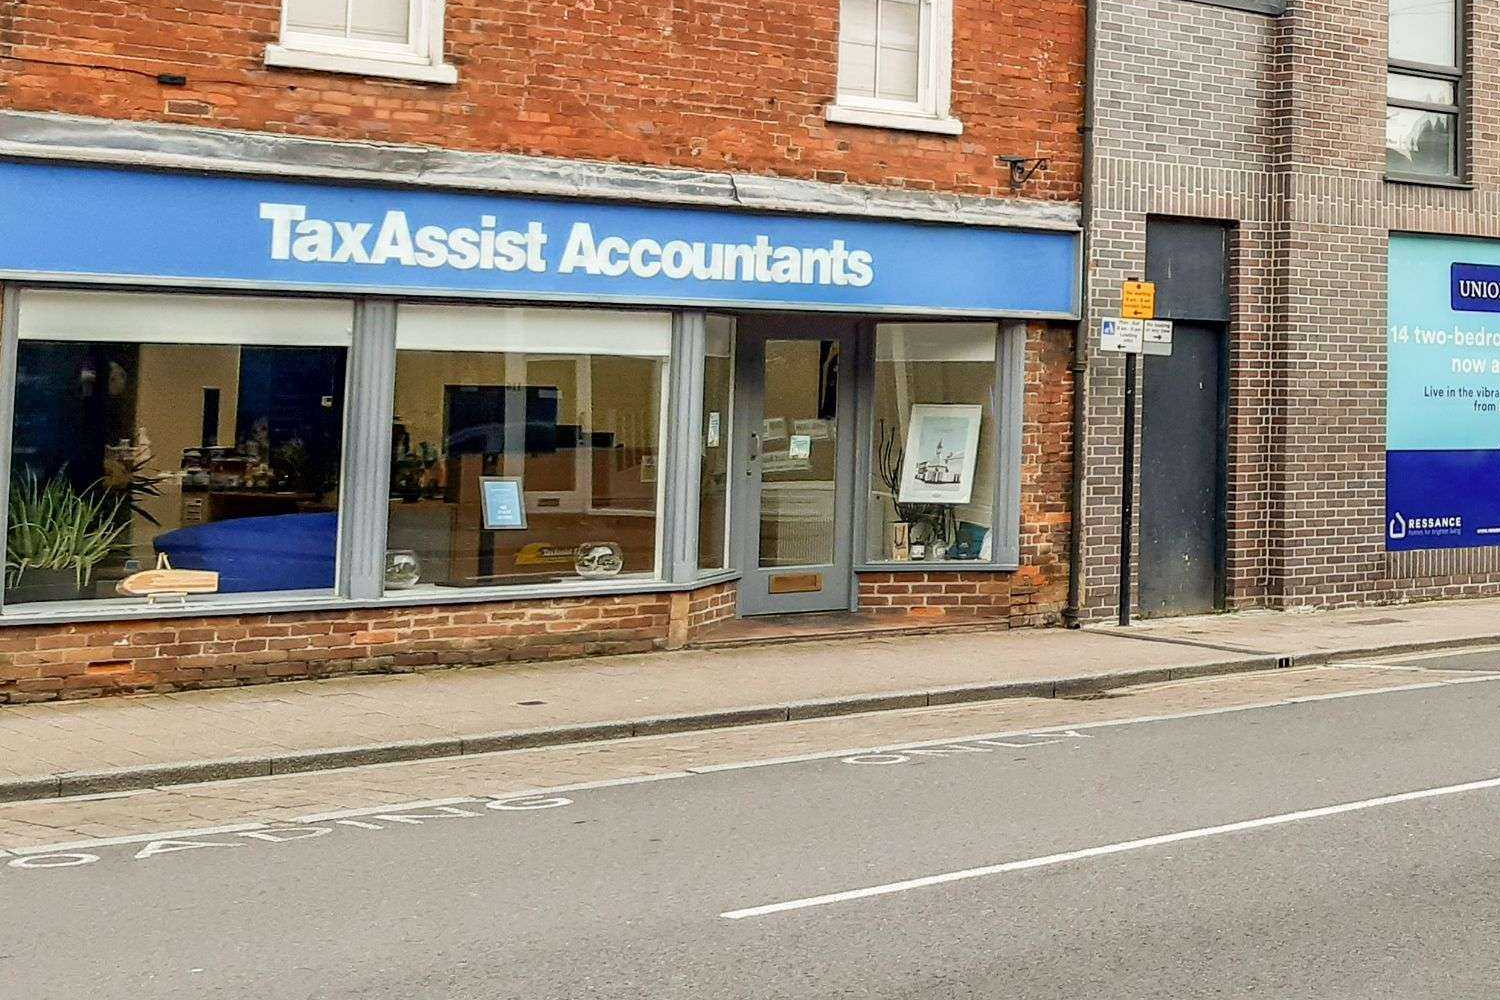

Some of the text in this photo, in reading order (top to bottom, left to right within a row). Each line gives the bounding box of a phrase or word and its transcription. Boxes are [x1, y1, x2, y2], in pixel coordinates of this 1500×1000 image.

[259, 201, 873, 287] TaxAssist Accountants
[1391, 325, 1409, 343] 14
[1451, 358, 1485, 374] now
[1424, 385, 1444, 397] Live
[1447, 386, 1456, 397] in
[1458, 386, 1473, 398] the
[1473, 400, 1496, 412] from
[1408, 517, 1461, 529] RESSANCE
[841, 729, 1095, 765] ONLY
[9, 795, 574, 868] OADING
